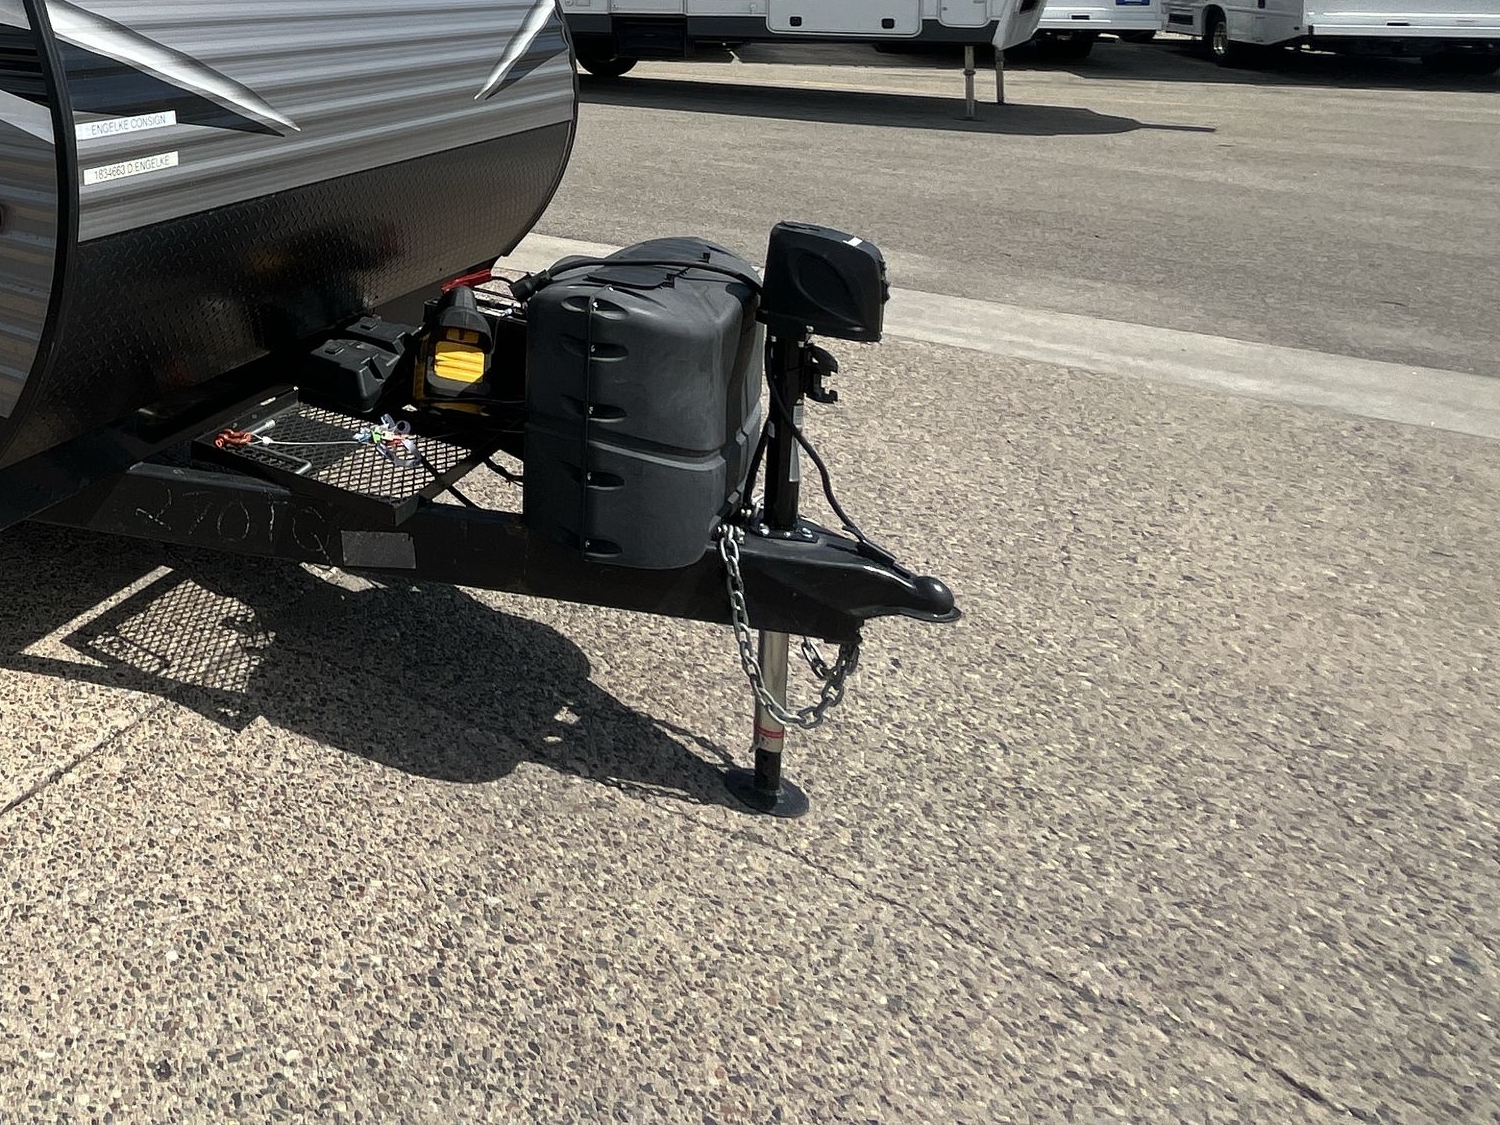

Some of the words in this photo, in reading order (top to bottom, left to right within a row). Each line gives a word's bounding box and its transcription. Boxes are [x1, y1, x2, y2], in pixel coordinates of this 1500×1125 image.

[91, 120, 129, 136] ENGELKE
[131, 115, 166, 129] CONSIGN
[94, 164, 126, 180] 1834663
[127, 162, 133, 174] D
[134, 155, 170, 172] ENGELKE
